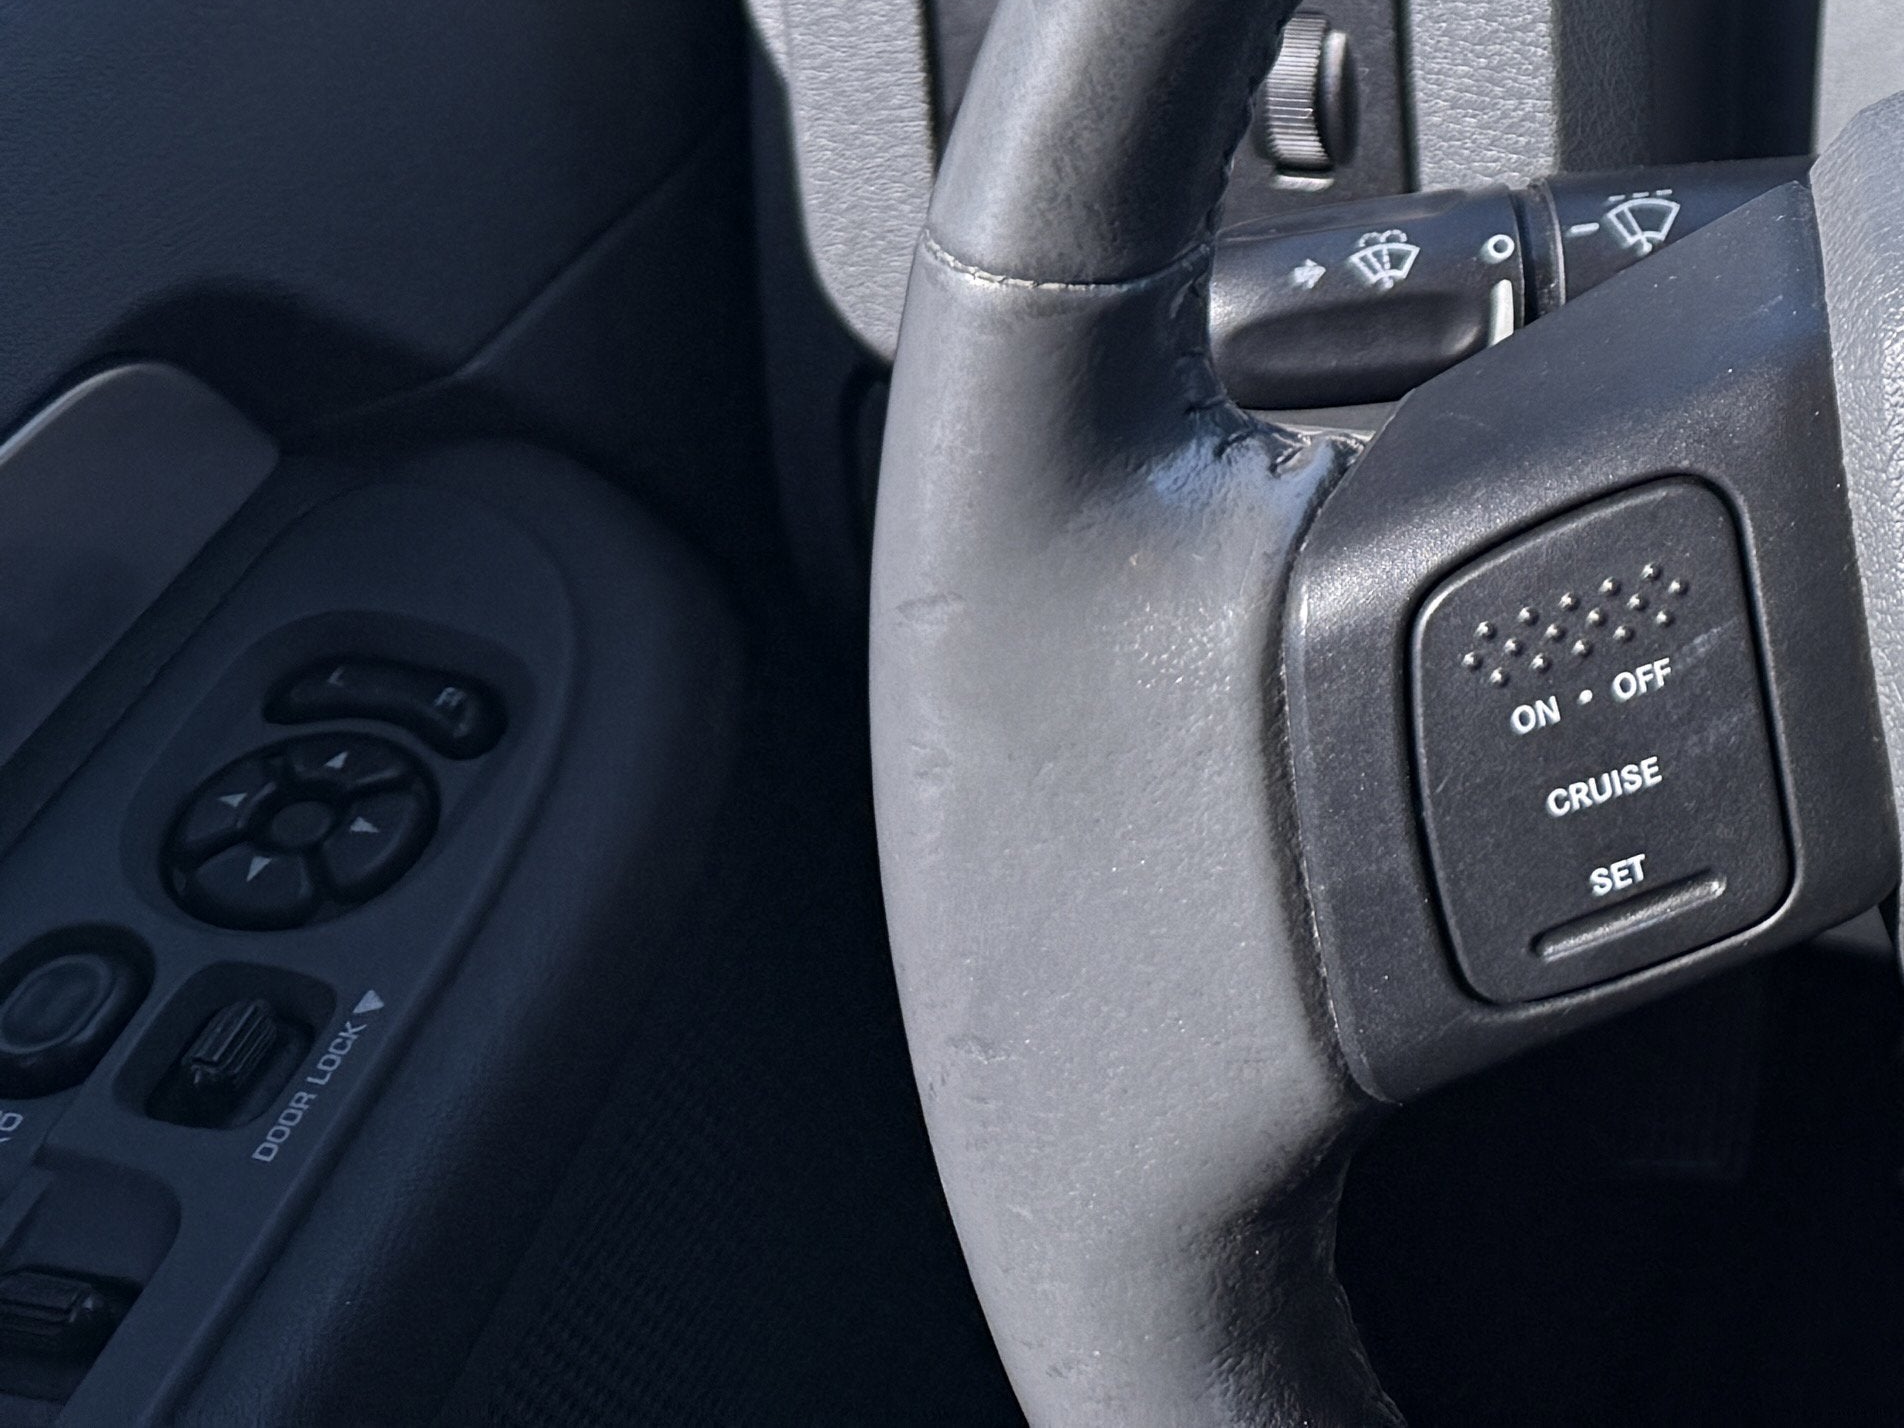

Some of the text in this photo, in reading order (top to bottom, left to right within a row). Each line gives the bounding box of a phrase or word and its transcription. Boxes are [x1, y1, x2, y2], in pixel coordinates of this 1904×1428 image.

[1511, 658, 1672, 735] ON OFF
[1546, 755, 1663, 819] CRUISE
[1590, 853, 1646, 896] SET
[252, 1020, 368, 1162] DOOR LOCK
